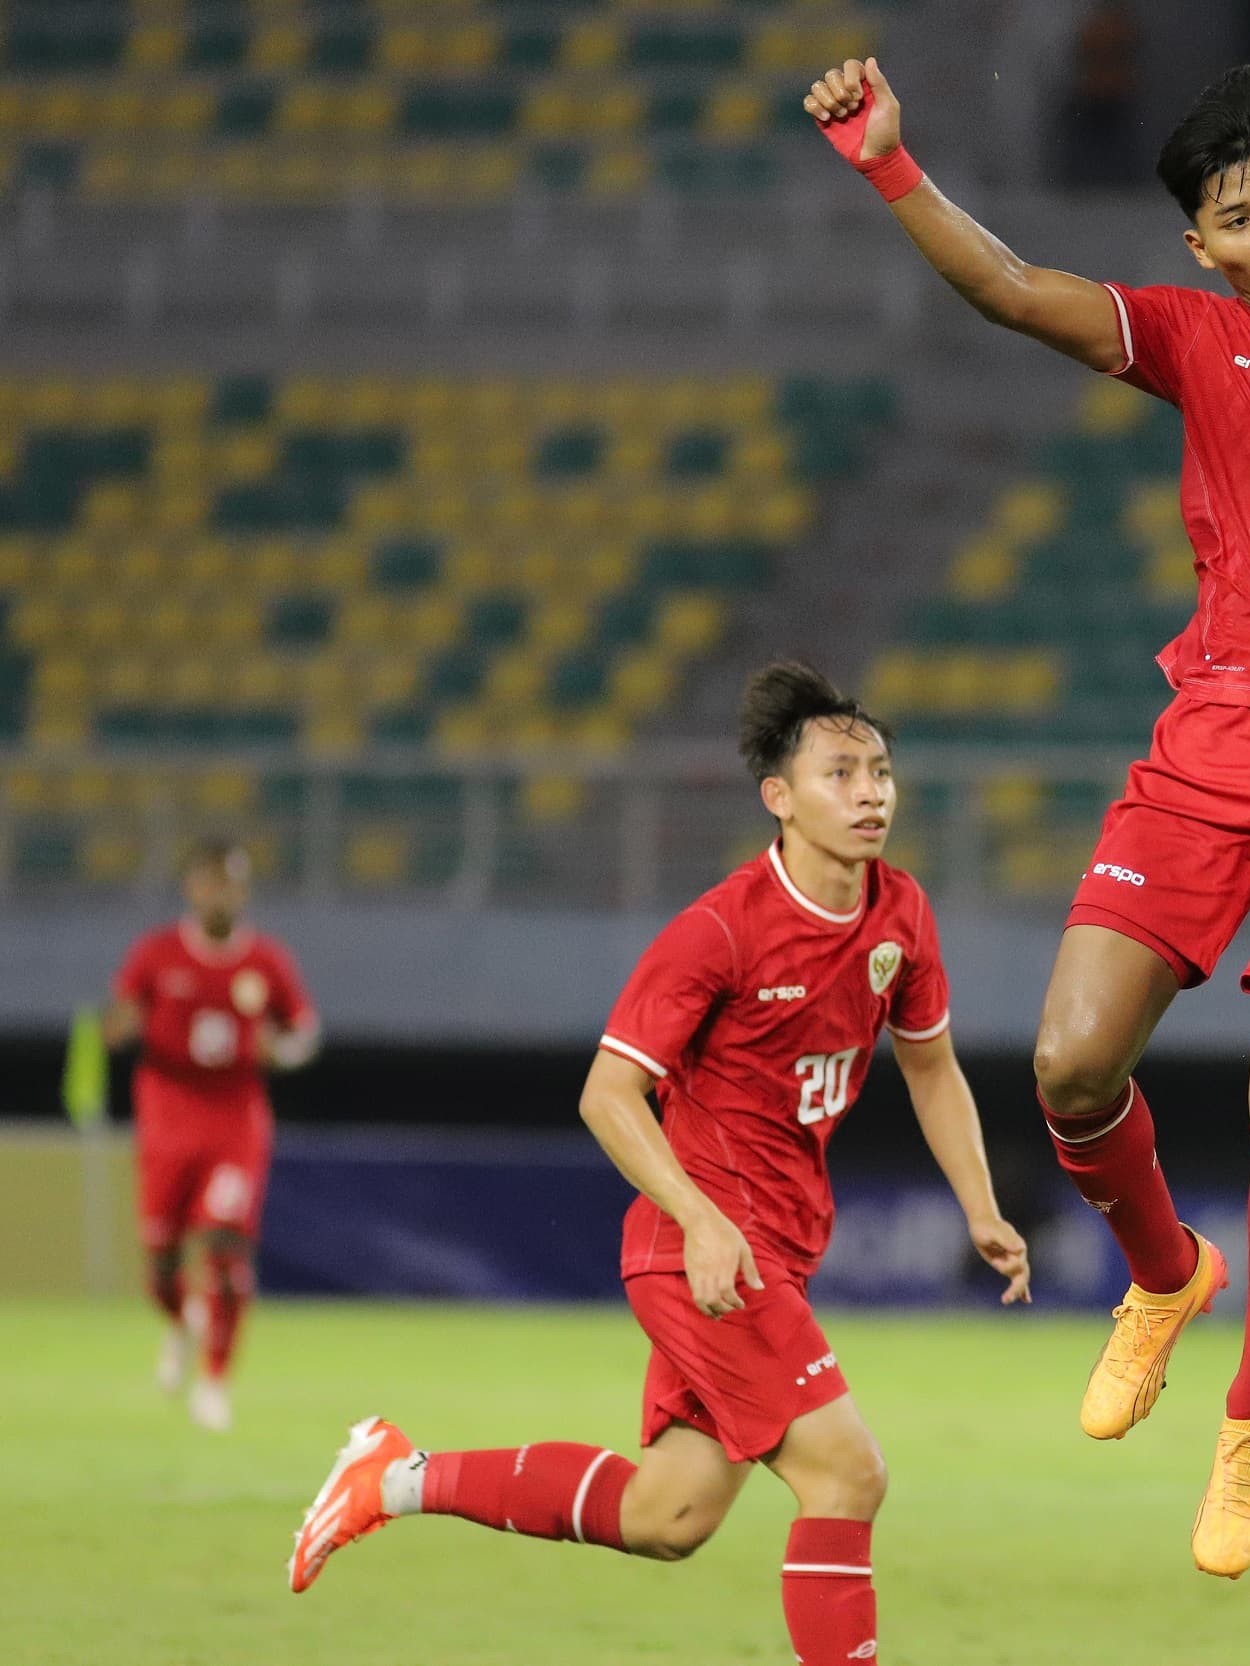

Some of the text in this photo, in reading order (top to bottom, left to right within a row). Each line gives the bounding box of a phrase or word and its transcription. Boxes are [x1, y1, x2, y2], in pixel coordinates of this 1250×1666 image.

[1093, 863, 1146, 887] erspo
[758, 985, 806, 1002] erspo
[795, 1046, 860, 1126] 20
